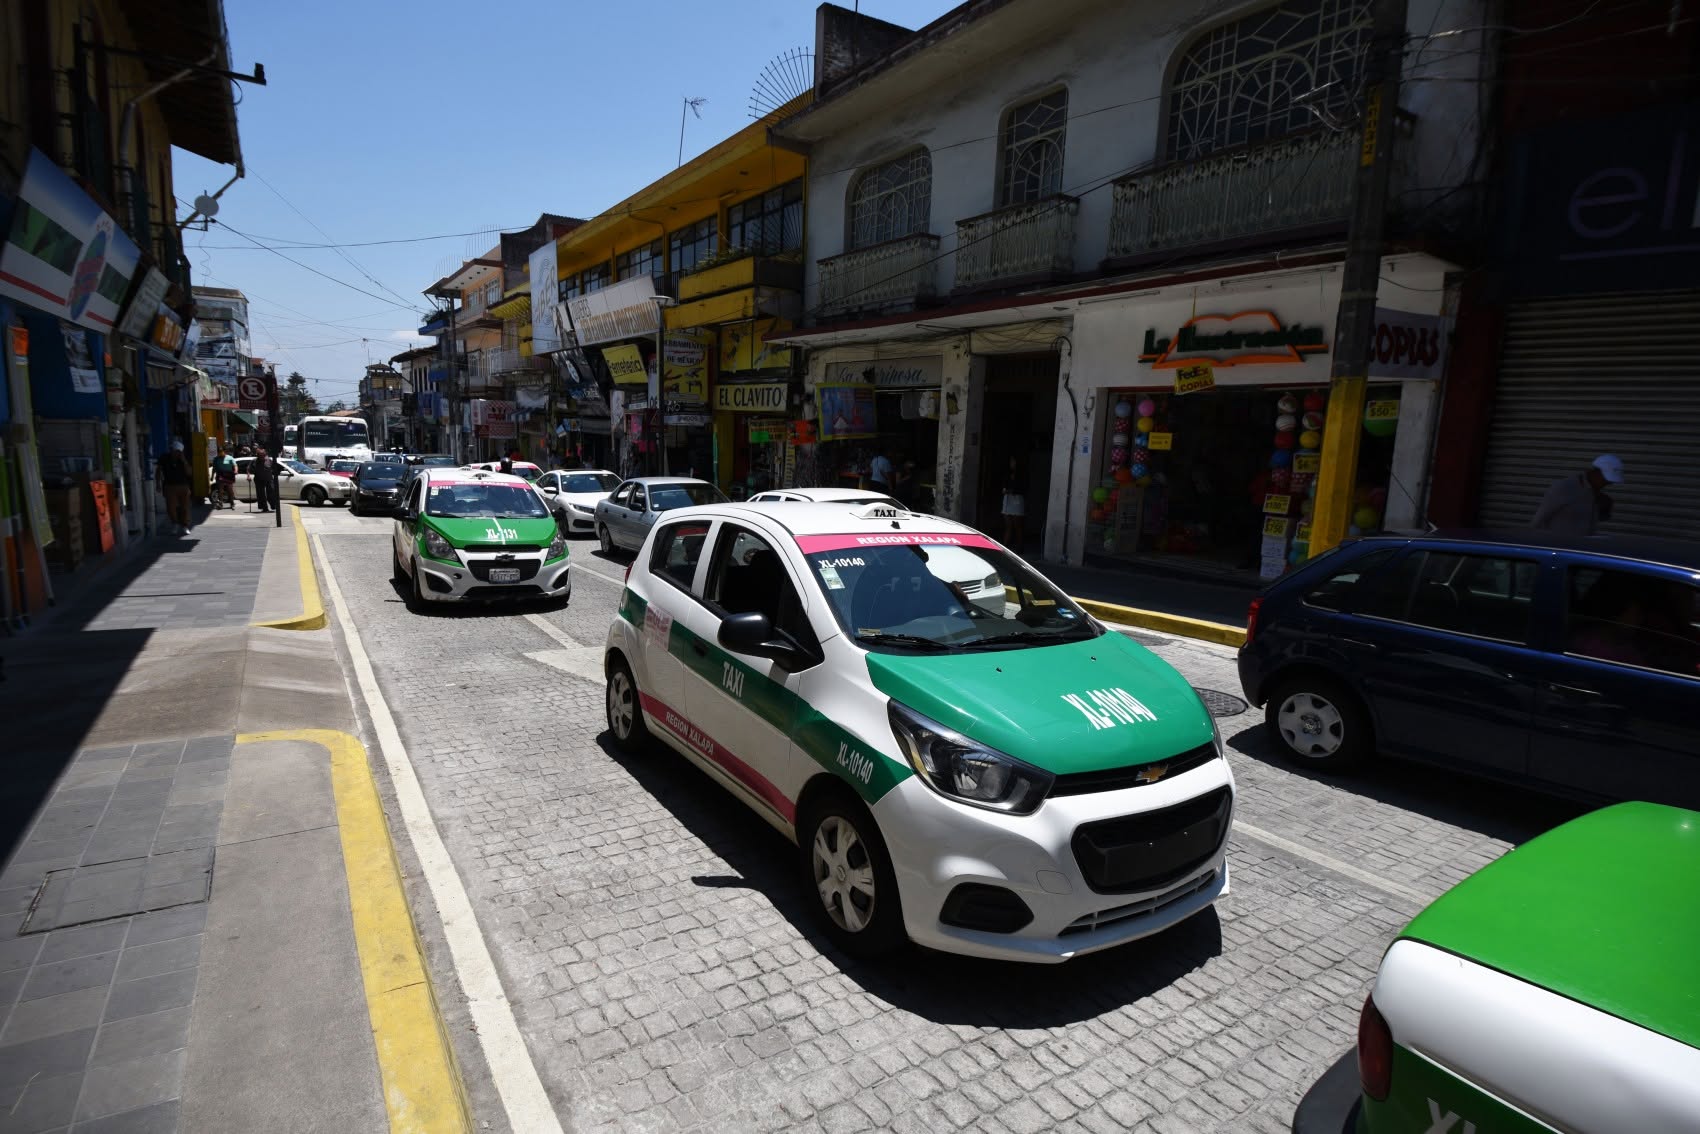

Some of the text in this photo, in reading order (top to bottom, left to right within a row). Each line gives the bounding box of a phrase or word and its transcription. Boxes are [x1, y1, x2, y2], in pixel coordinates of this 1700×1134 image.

[1177, 367, 1209, 380] FedEx
[719, 387, 782, 407] EL CLAVITO
[873, 508, 897, 518] TAXI
[857, 535, 961, 545] REGION XALAPA
[818, 557, 865, 569] XL-10140
[722, 660, 745, 698] TAXI
[1060, 687, 1158, 731] XL-10140
[666, 711, 715, 756] REGION XALAPA
[836, 740, 874, 786] XL-10140
[1424, 1097, 1477, 1134] X
